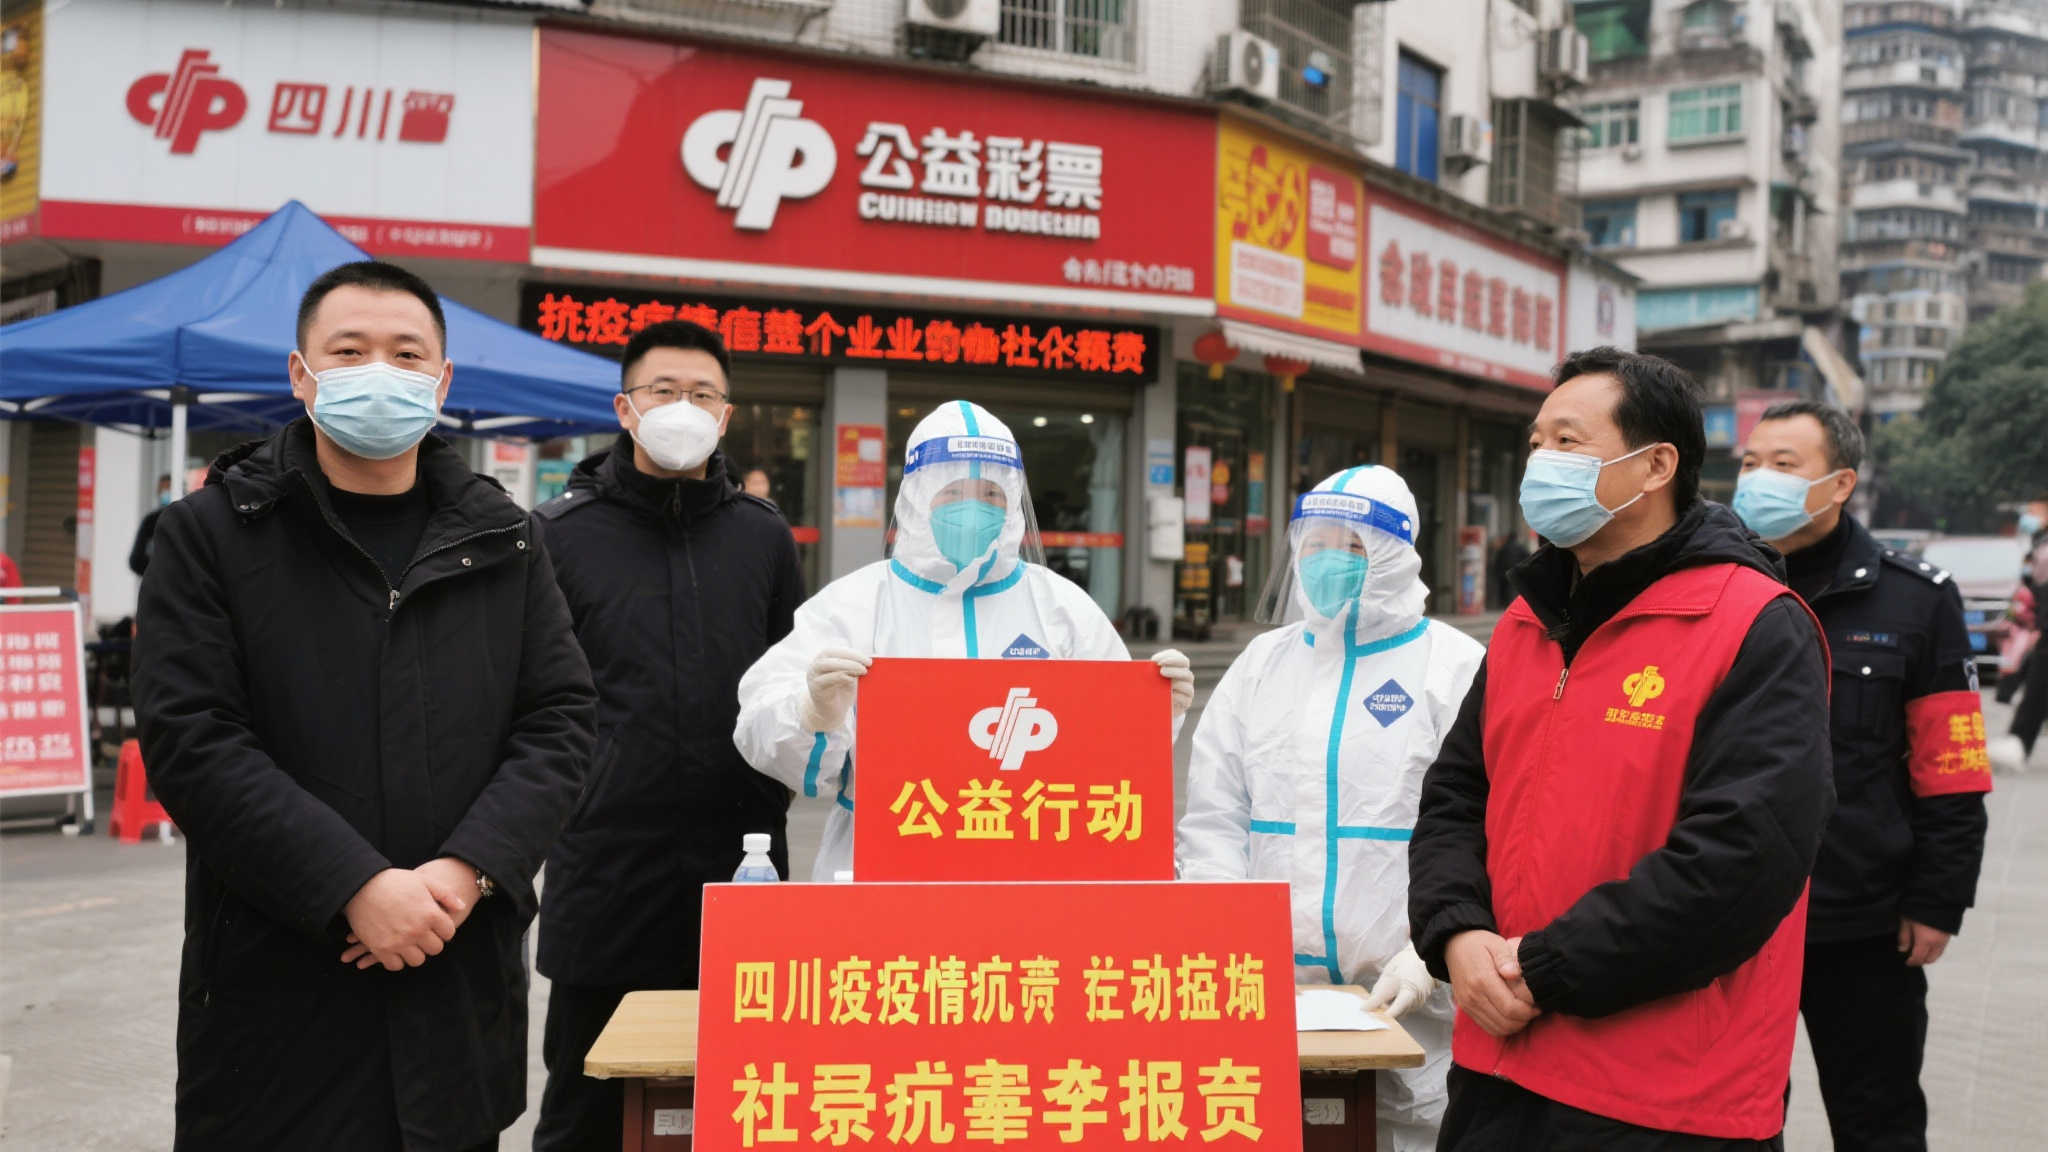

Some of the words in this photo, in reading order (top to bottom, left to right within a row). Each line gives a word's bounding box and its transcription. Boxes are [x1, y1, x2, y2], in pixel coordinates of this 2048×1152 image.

[856, 122, 1103, 210] 公益彩票
[889, 778, 1143, 842] 公益行动
